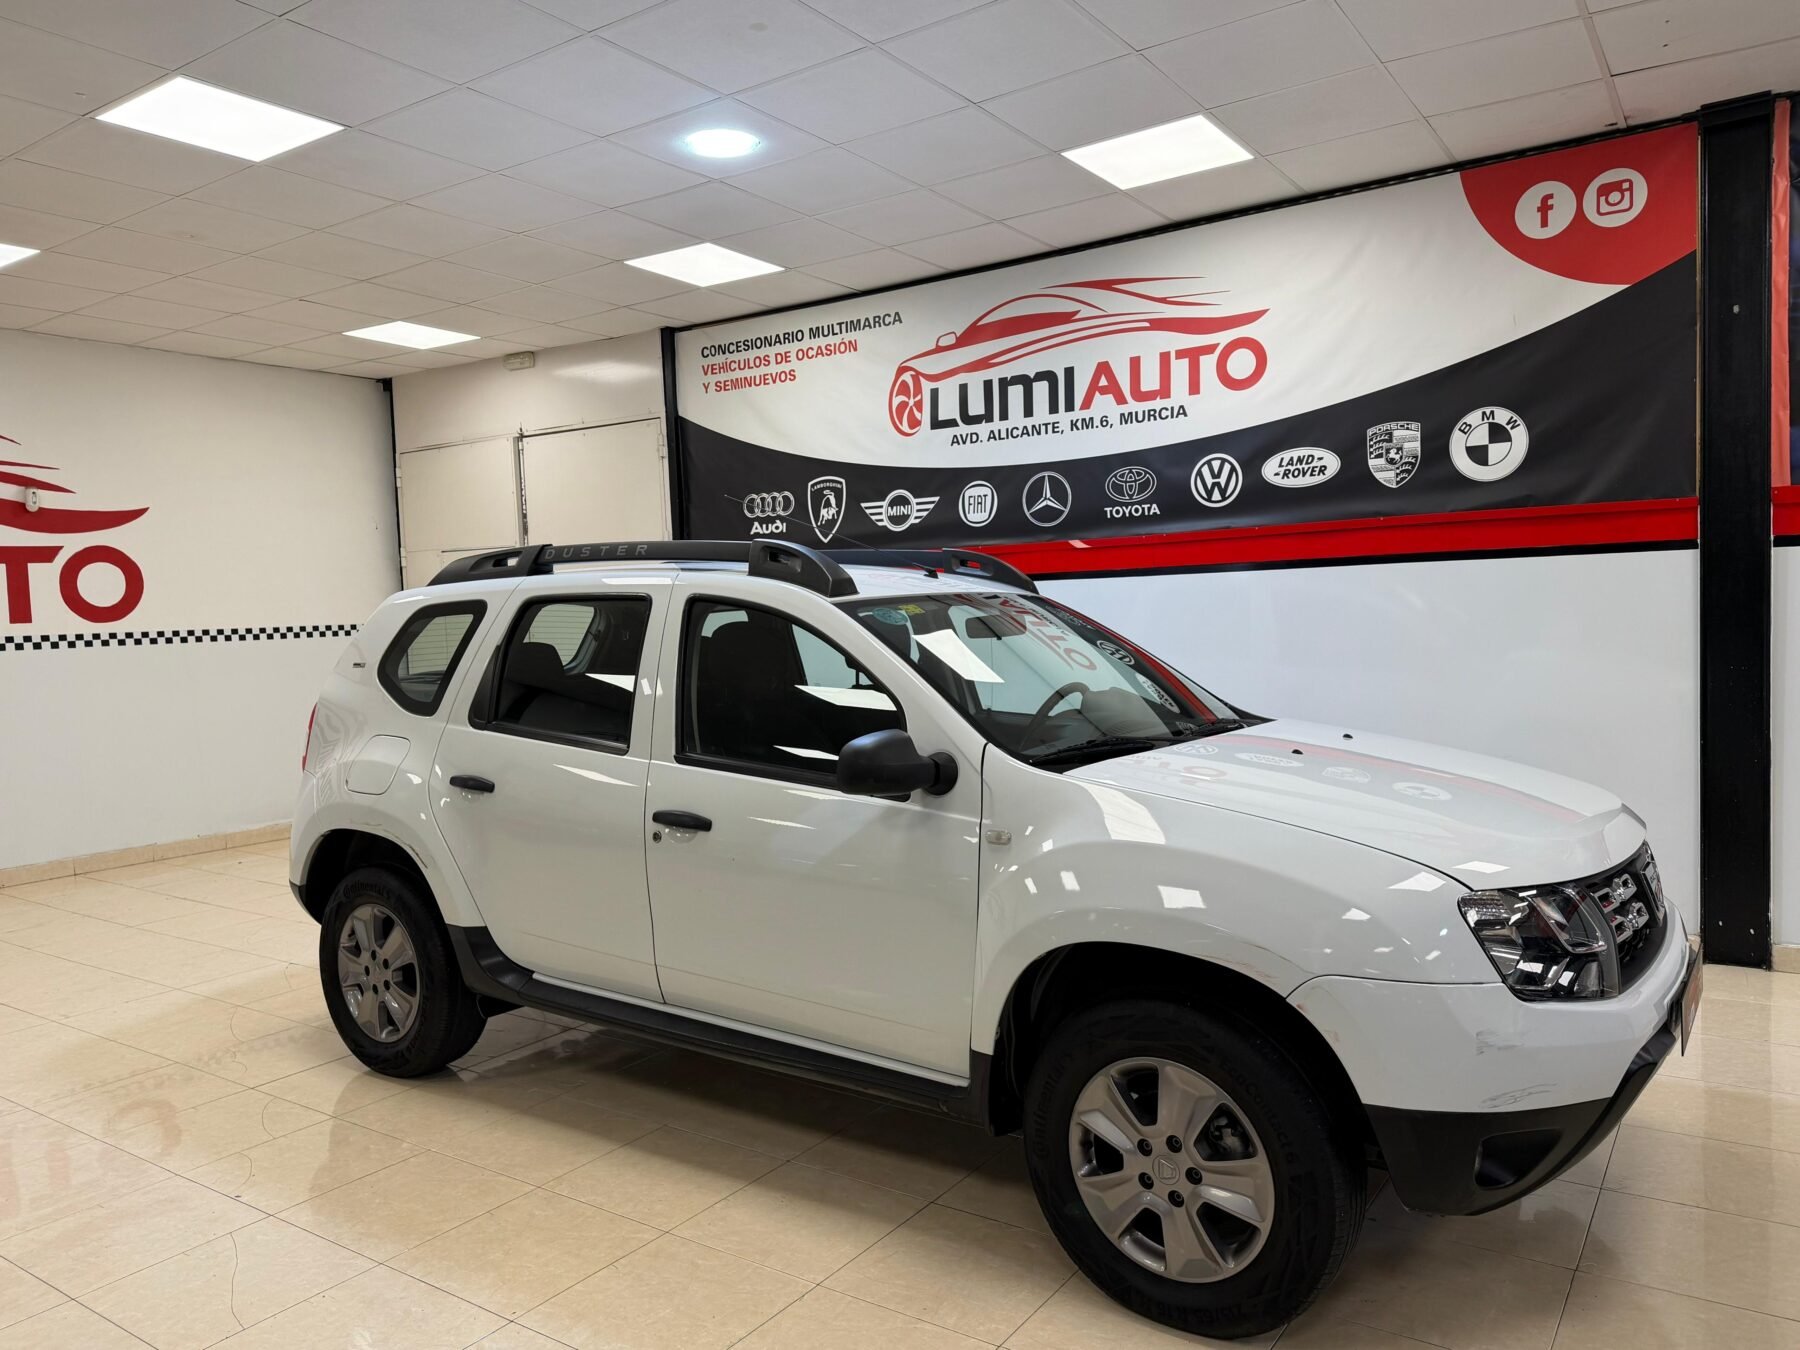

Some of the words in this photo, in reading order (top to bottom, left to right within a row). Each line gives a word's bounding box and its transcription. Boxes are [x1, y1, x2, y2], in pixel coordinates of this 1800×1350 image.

[701, 328, 805, 359] CONCESIONARIO
[808, 311, 903, 341] MULTIMARCA
[701, 353, 771, 377] VEHÍCULOS
[774, 350, 792, 365] DE
[795, 339, 858, 361] OCASIÓN
[702, 381, 711, 394] Y
[714, 369, 797, 393] SEMINUEVOS
[950, 430, 983, 446] AVD.
[986, 420, 1065, 442] ALICANTE,
[1070, 415, 1114, 432] KM.6,
[1118, 404, 1189, 426] MURCIA
[1369, 423, 1419, 436] PORSCHE
[1458, 409, 1521, 436] BMW
[887, 504, 912, 517] MINI
[967, 494, 989, 515] FIAT
[1104, 503, 1160, 519] TOYOTA
[750, 519, 787, 535] Audi
[544, 544, 648, 560] DUSTER
